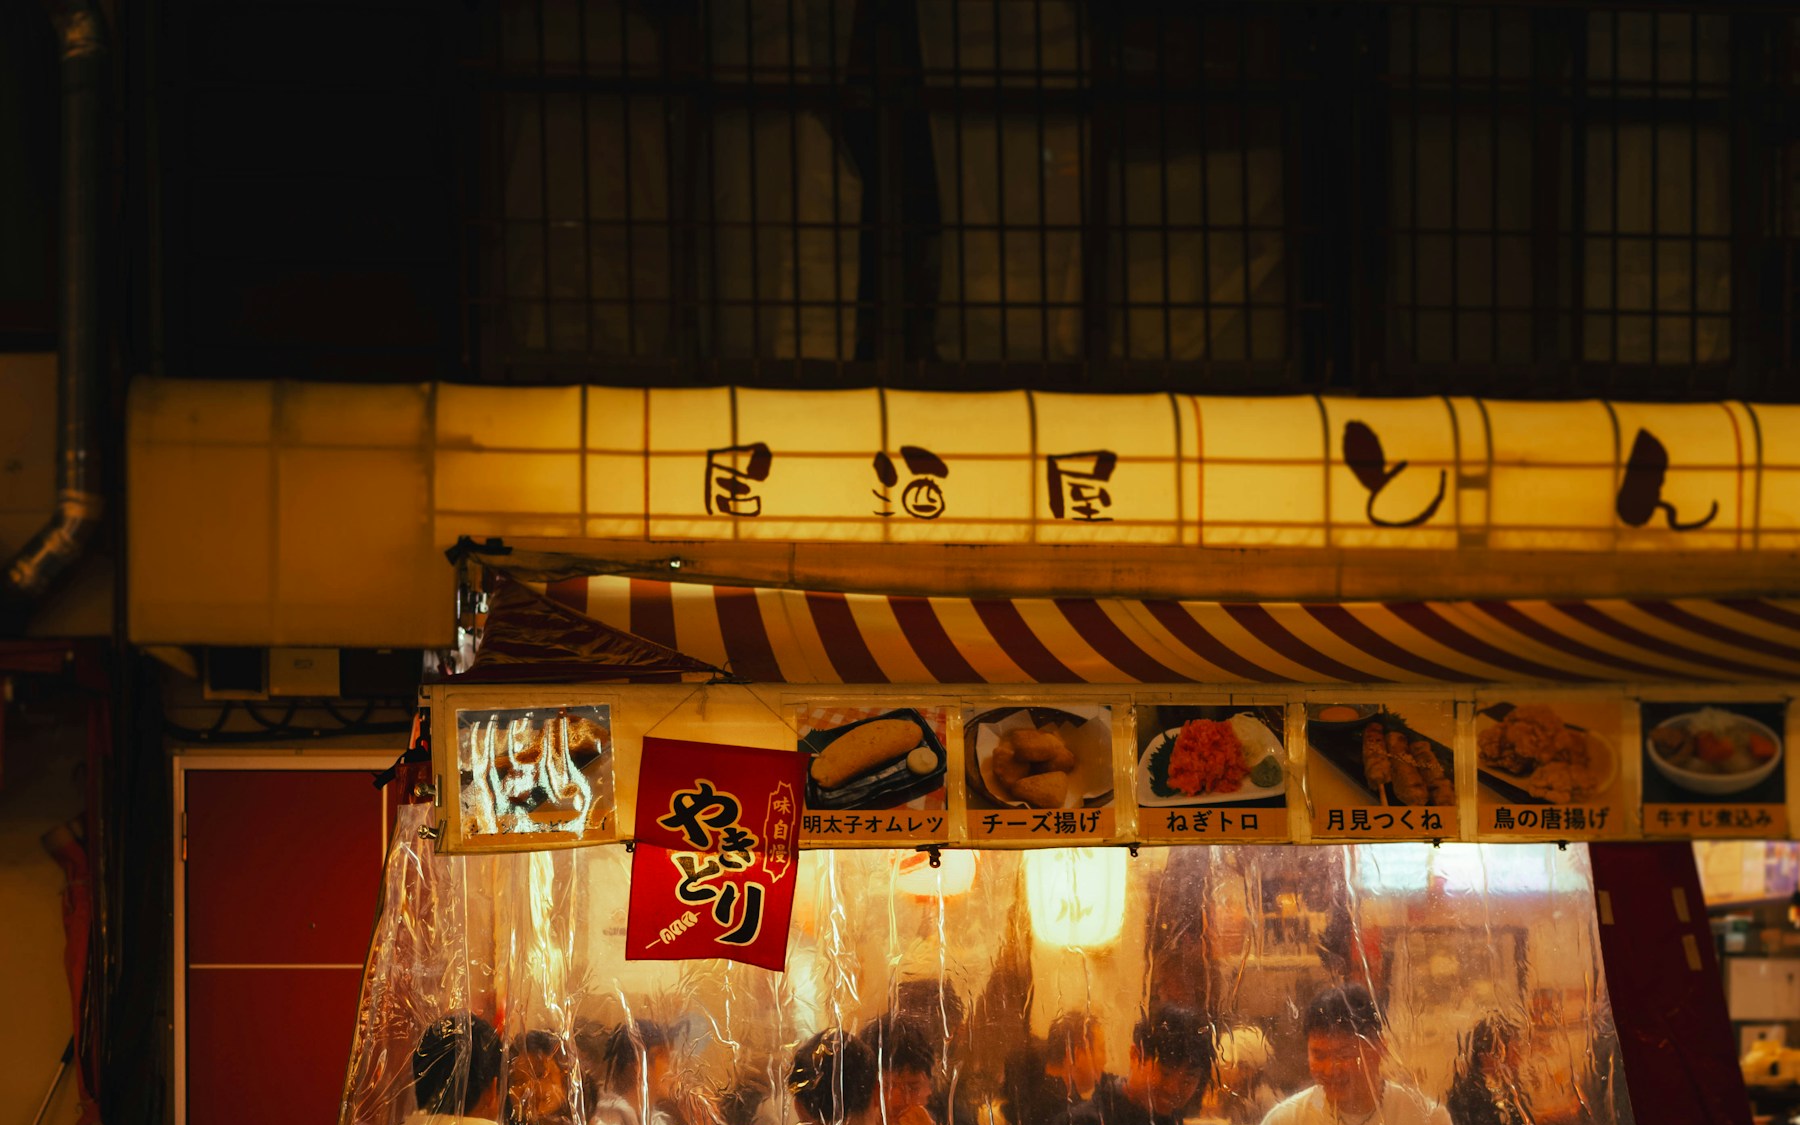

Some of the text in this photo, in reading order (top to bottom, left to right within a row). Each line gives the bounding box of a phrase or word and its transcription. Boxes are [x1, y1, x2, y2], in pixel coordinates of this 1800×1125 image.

[704, 442, 1117, 521] 居酒屋
[769, 796, 790, 864] 味自慢
[803, 815, 944, 834] 明太子オムレツ
[982, 810, 1101, 834] チーズ揚げ
[1166, 809, 1259, 833] ねぎトロ
[1327, 809, 1443, 832] 月見つくね
[1494, 806, 1610, 830] 鳥の唐揚げ
[656, 778, 764, 946] やきとり
